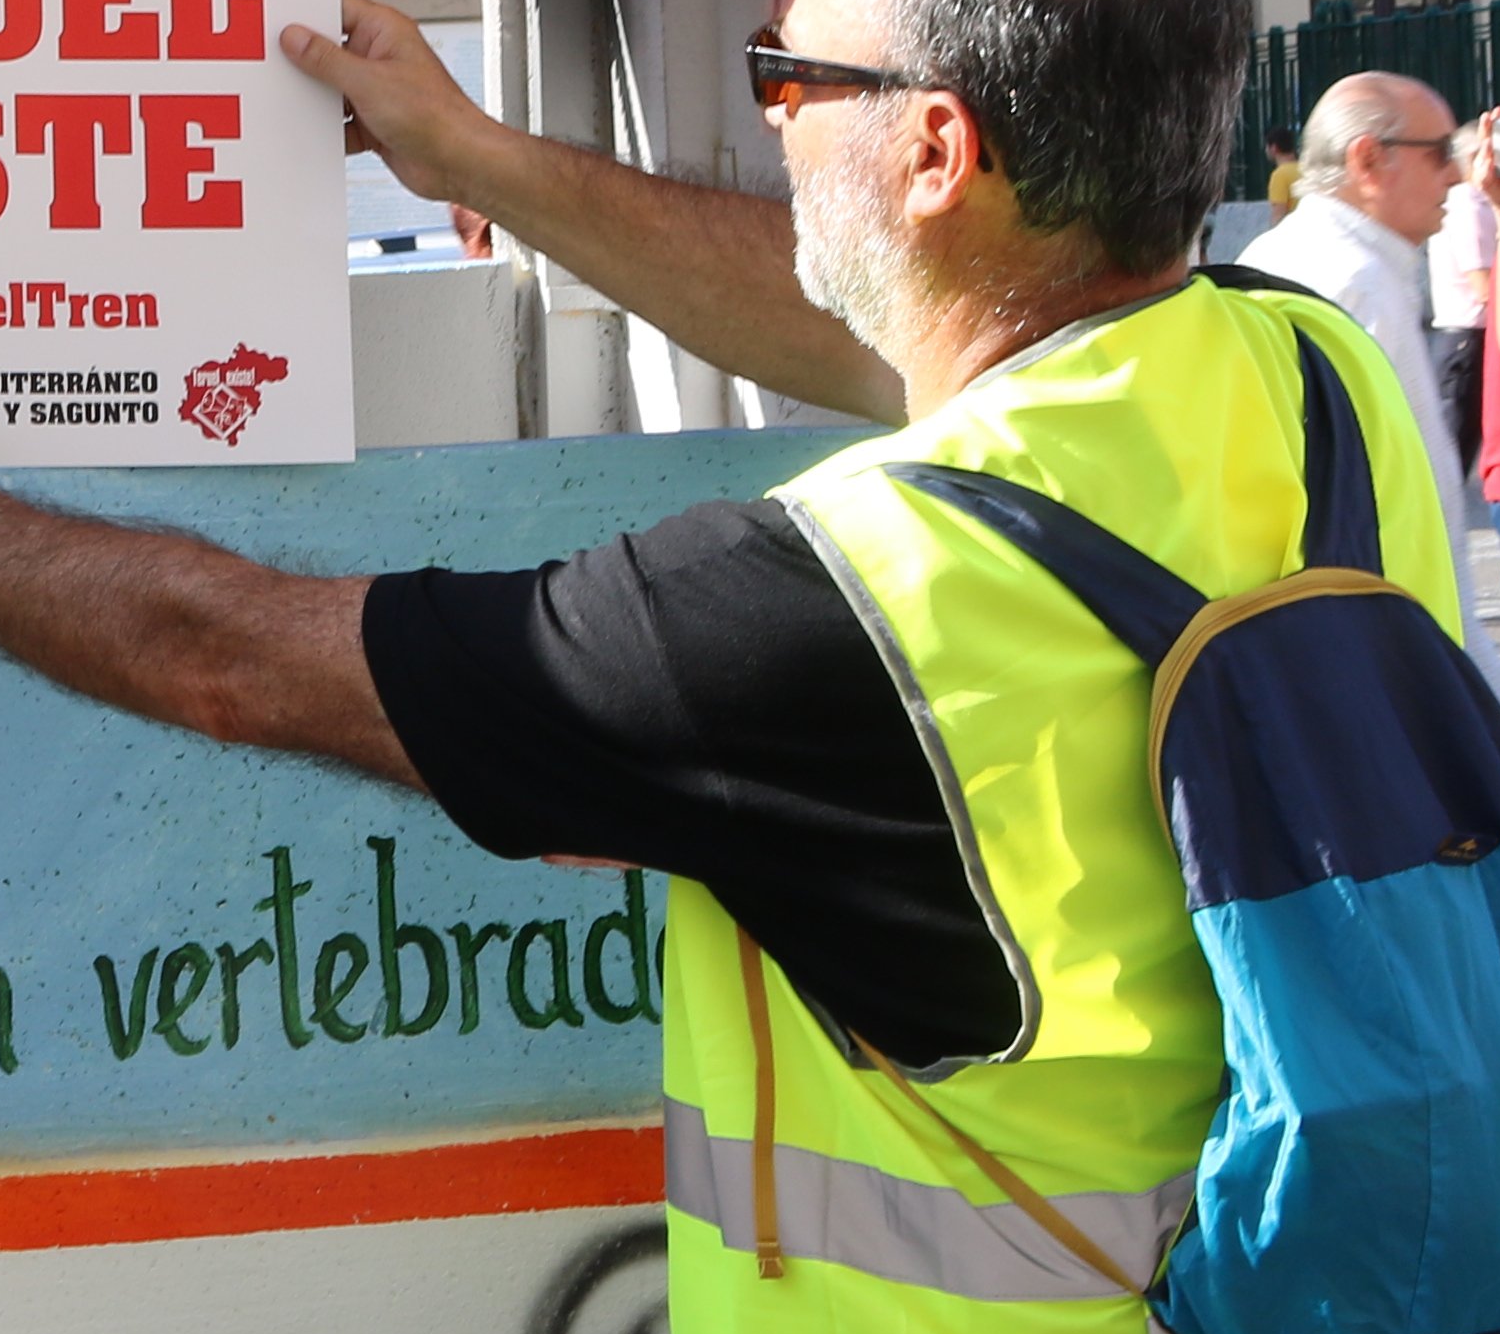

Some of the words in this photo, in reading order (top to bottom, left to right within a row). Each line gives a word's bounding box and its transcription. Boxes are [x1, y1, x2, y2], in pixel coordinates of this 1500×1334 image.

[3, 402, 24, 425] Y
[30, 400, 160, 425] SAGUNTO
[94, 835, 666, 1061] vertebrad
